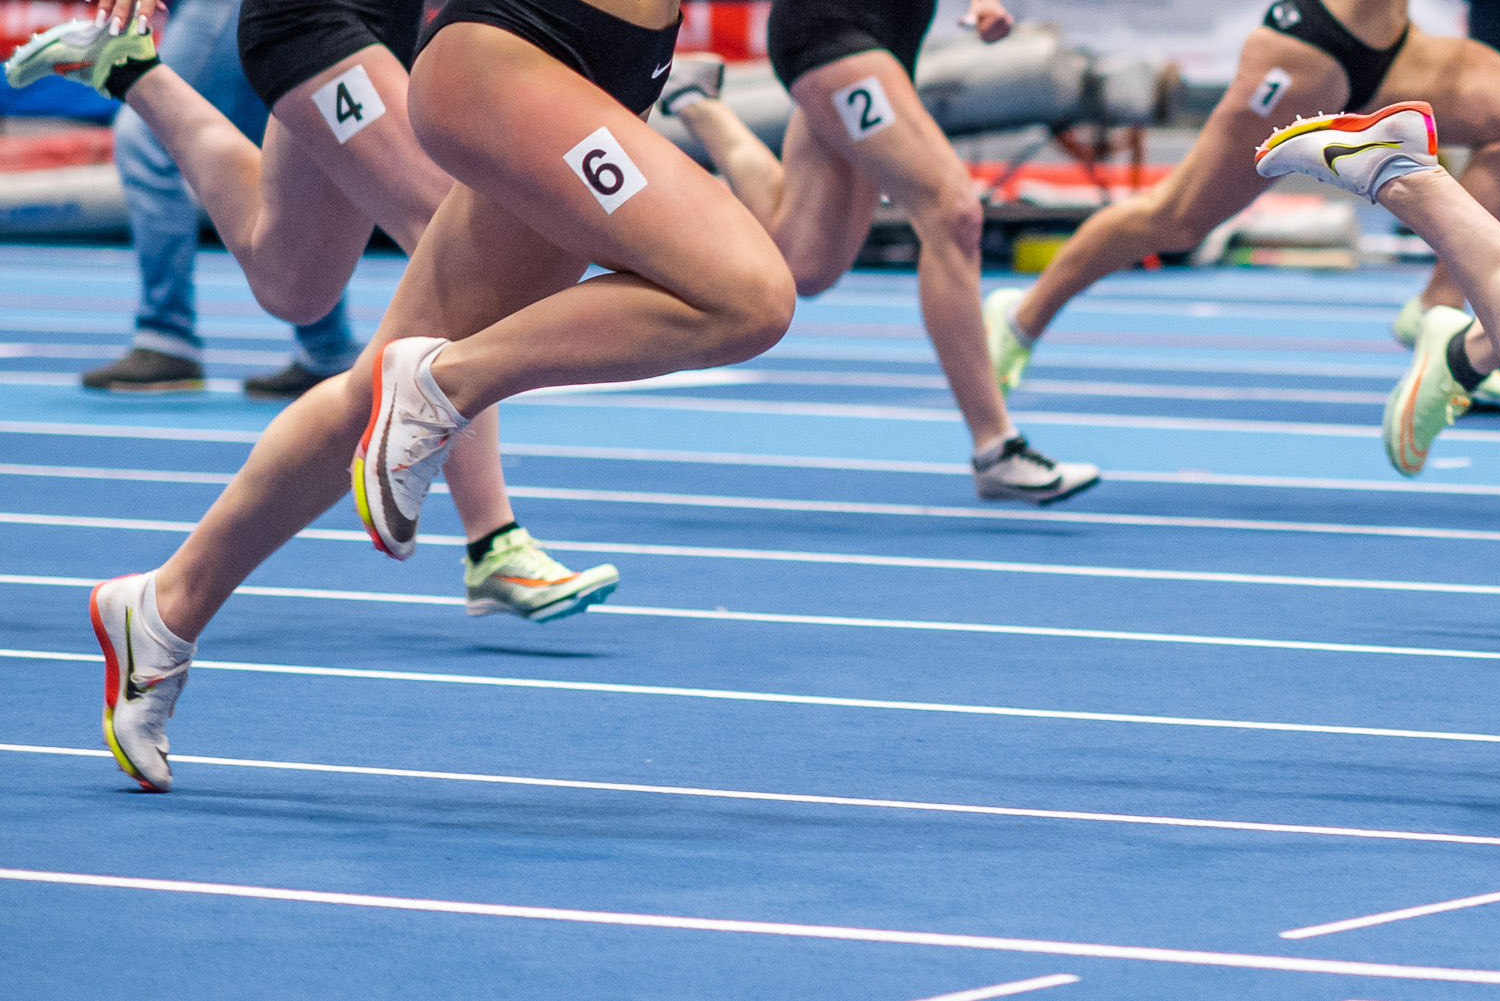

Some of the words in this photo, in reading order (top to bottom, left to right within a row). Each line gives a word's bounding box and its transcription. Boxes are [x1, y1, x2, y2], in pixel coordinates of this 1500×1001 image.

[336, 81, 363, 124] 4
[847, 88, 883, 131] 2
[1261, 82, 1281, 106] 1
[582, 149, 625, 196] 6
